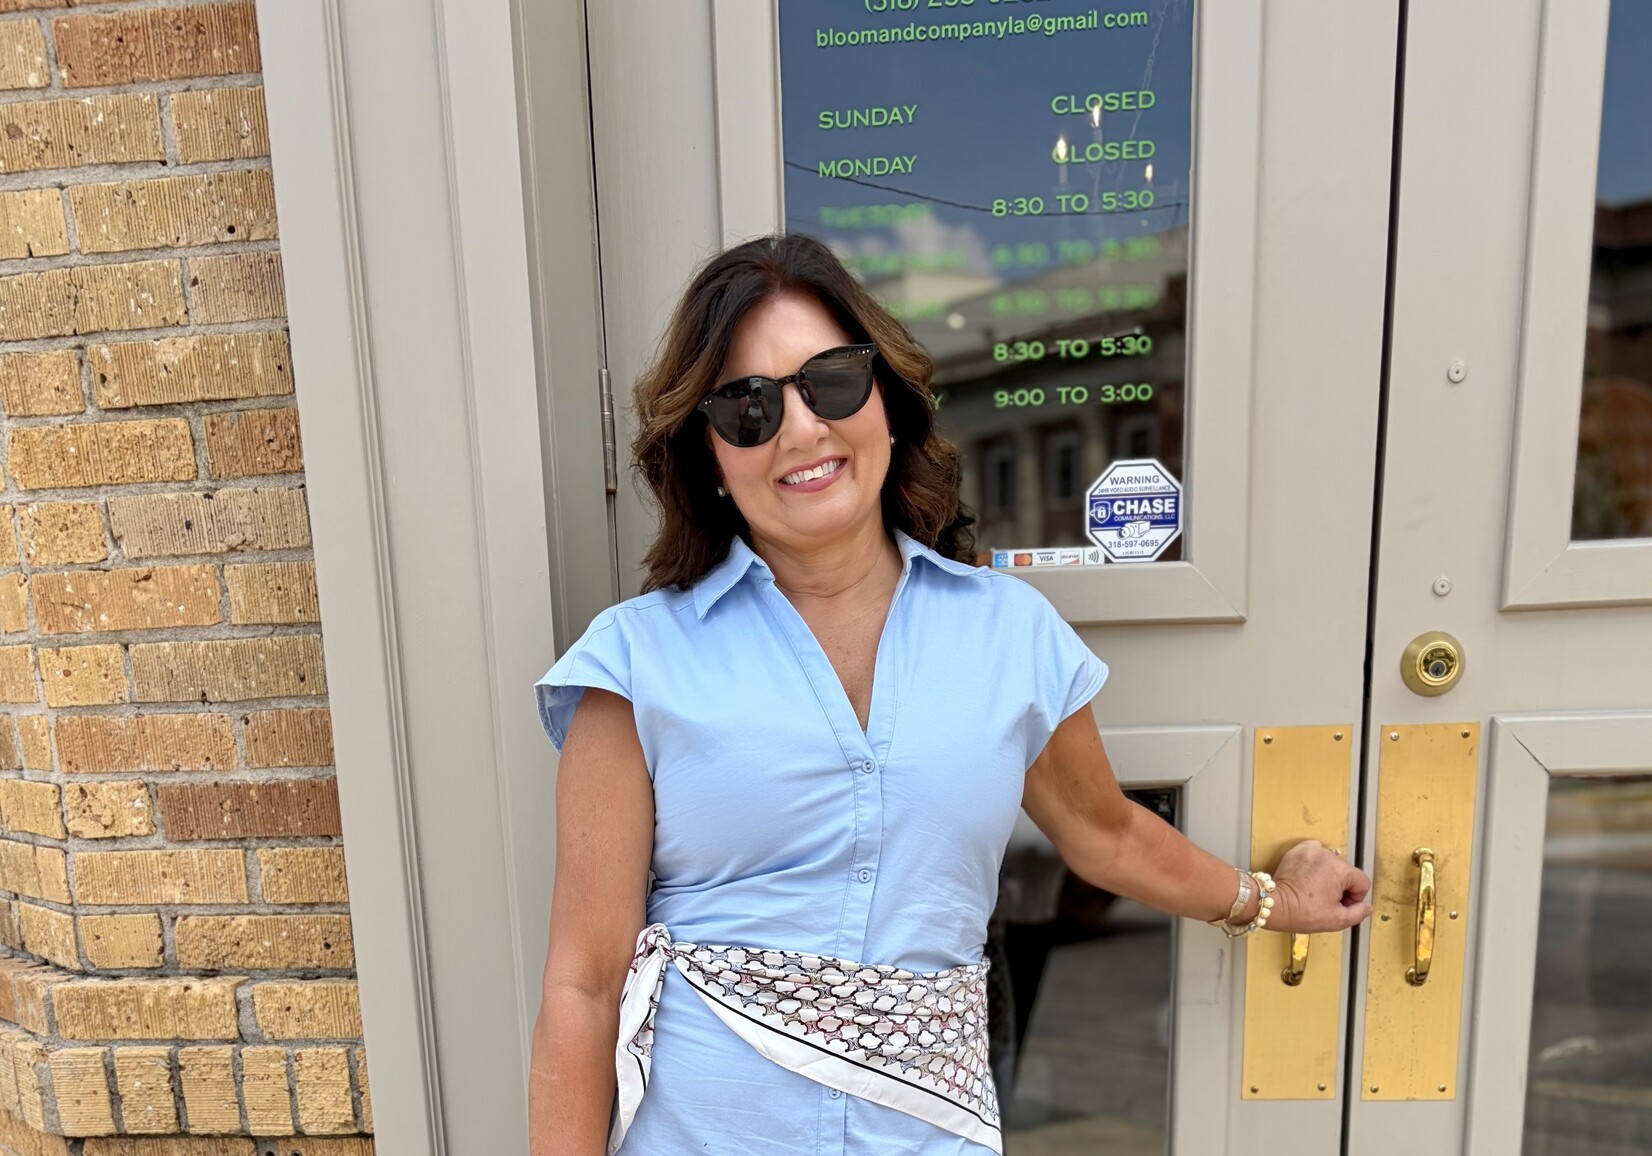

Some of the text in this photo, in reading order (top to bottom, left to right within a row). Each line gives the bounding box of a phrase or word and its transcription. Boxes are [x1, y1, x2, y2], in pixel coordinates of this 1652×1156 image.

[1051, 90, 1155, 114] CLOSED
[819, 104, 918, 129] SUNDAY
[1051, 140, 1155, 164] CLOSED
[819, 155, 918, 178] MONDAY
[992, 190, 1154, 217] 8:30 TO 5:30
[993, 336, 1151, 361] 8:30 TO 5:30
[994, 384, 1153, 408] 9:00 TO 3:00
[1109, 475, 1160, 485] WARNING
[1113, 498, 1176, 515] CHASE
[1108, 540, 1160, 549] 318-597-0695
